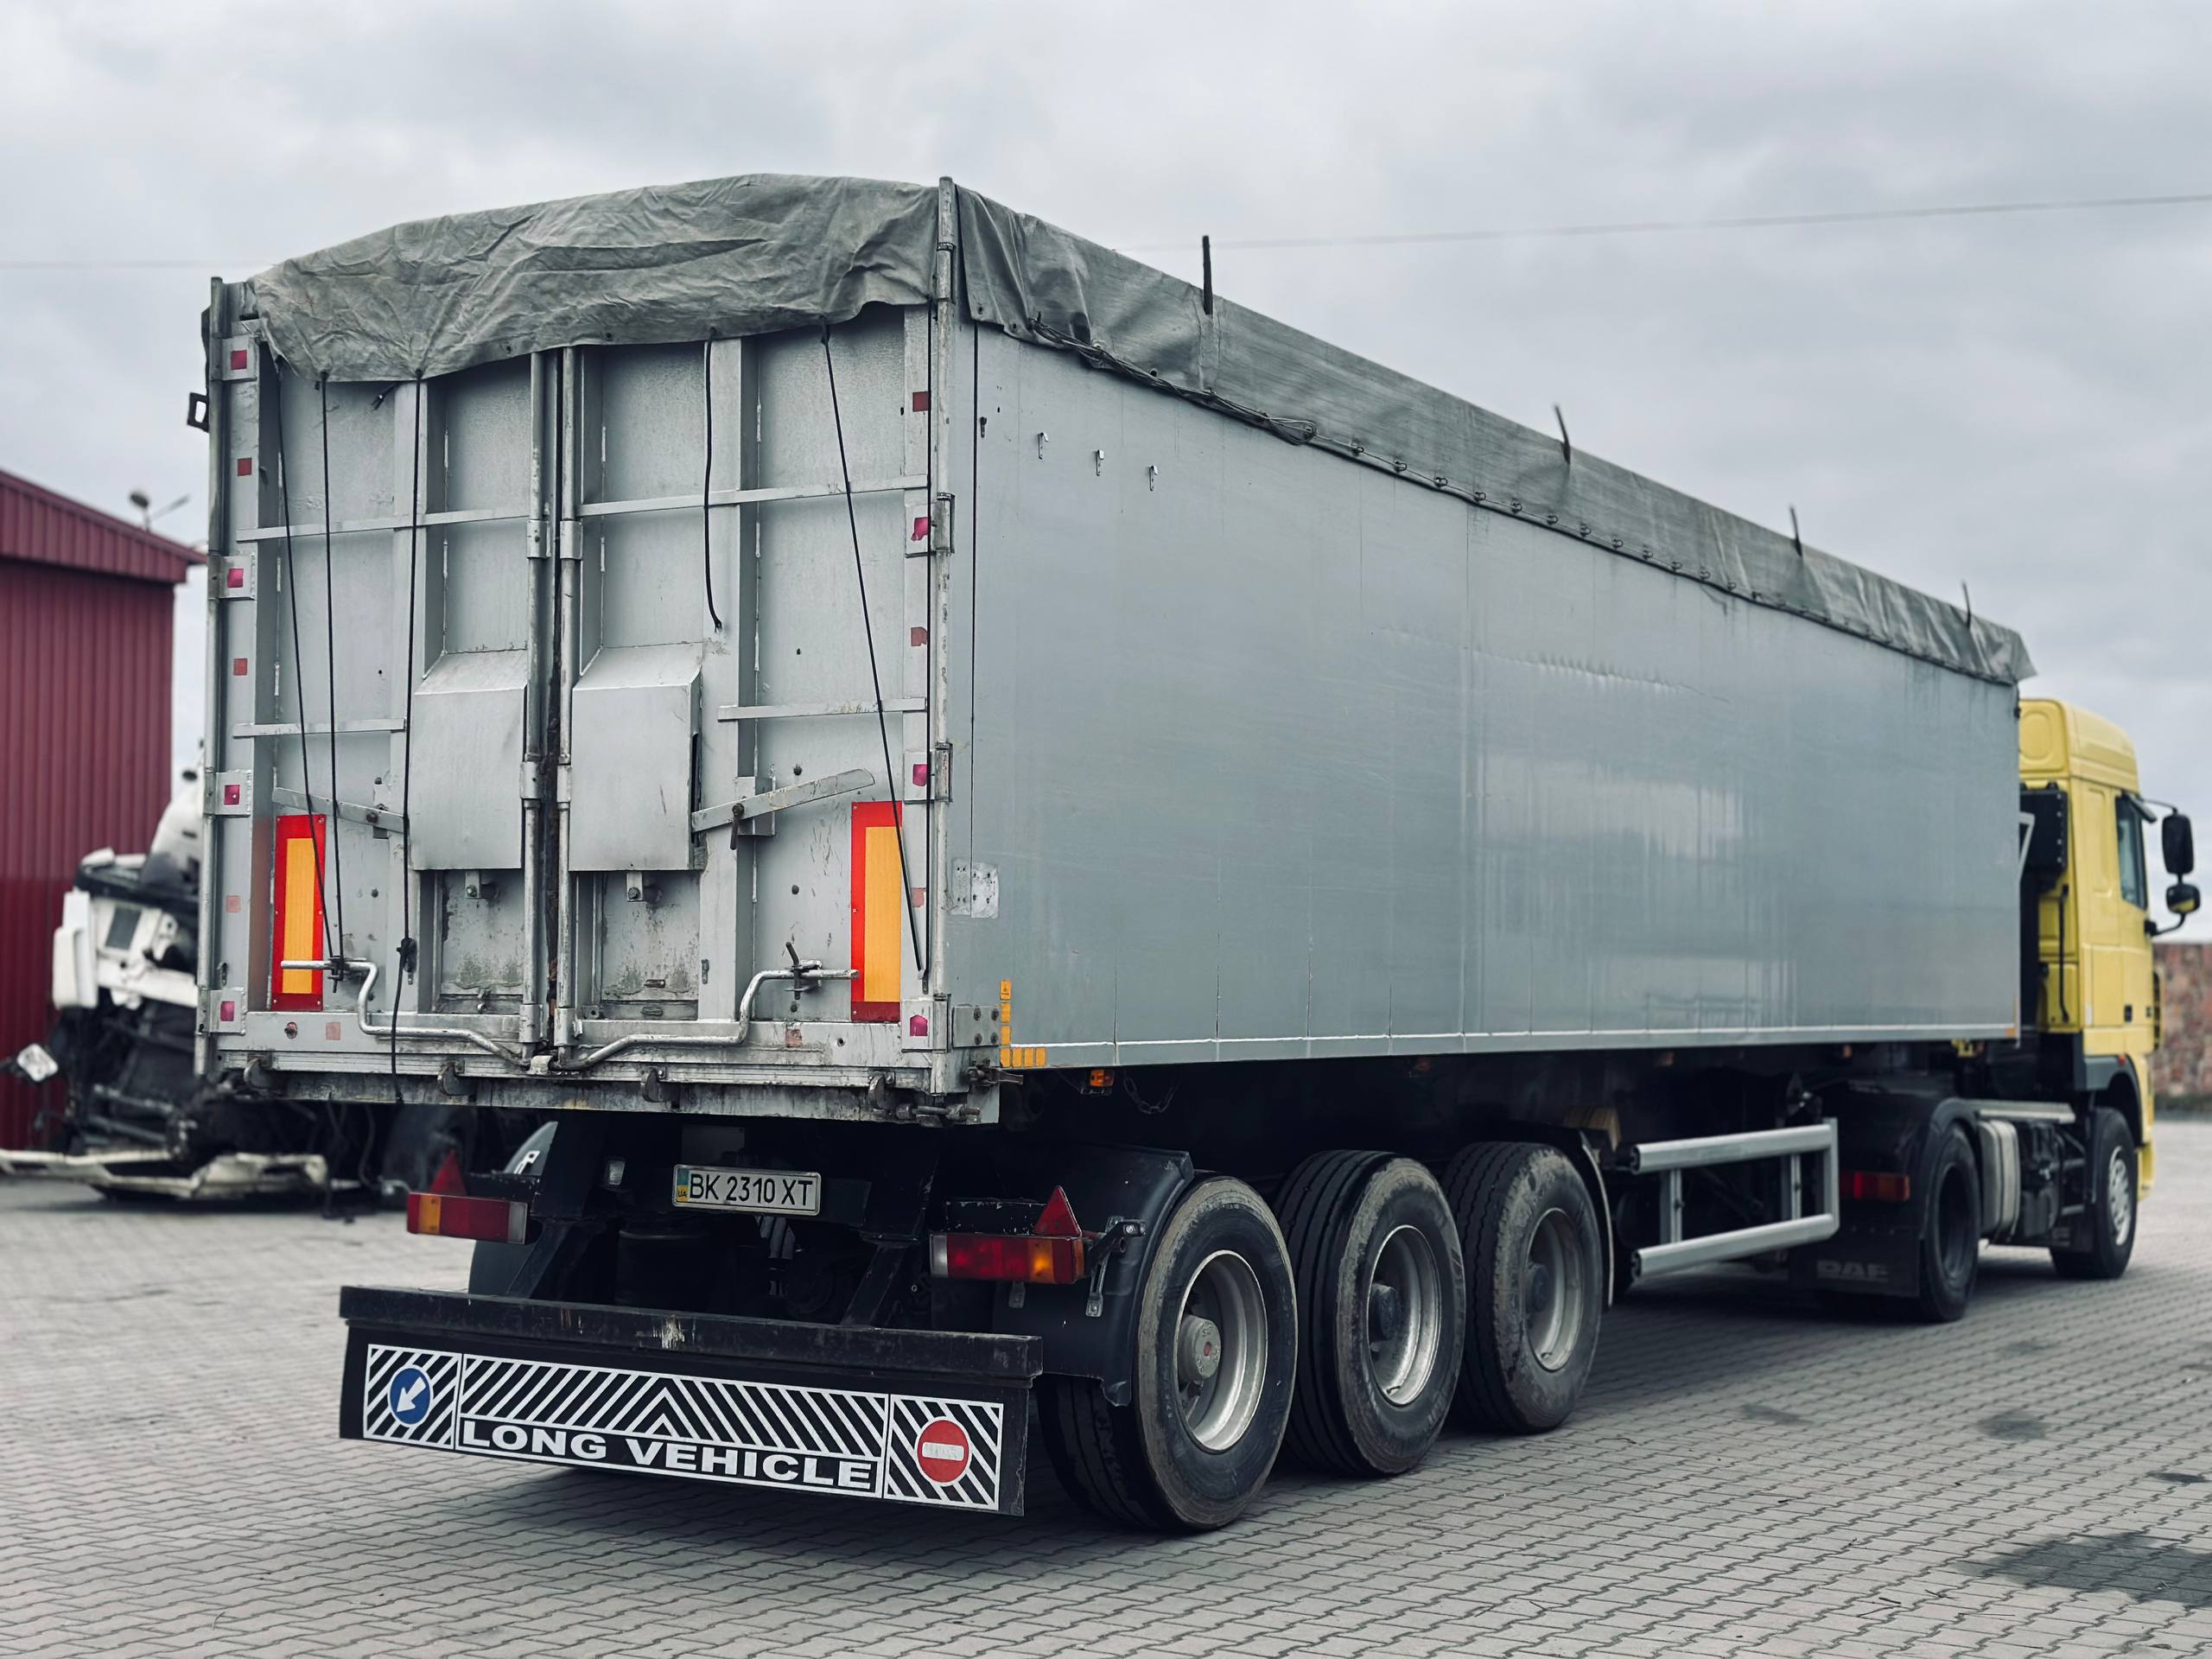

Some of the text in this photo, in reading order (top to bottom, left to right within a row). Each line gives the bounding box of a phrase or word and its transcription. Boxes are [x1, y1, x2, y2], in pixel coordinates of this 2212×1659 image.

[677, 1190, 688, 1198] UA
[690, 1173, 813, 1206] BK 2310 XT
[462, 1420, 872, 1490] LONG VEHICLE
